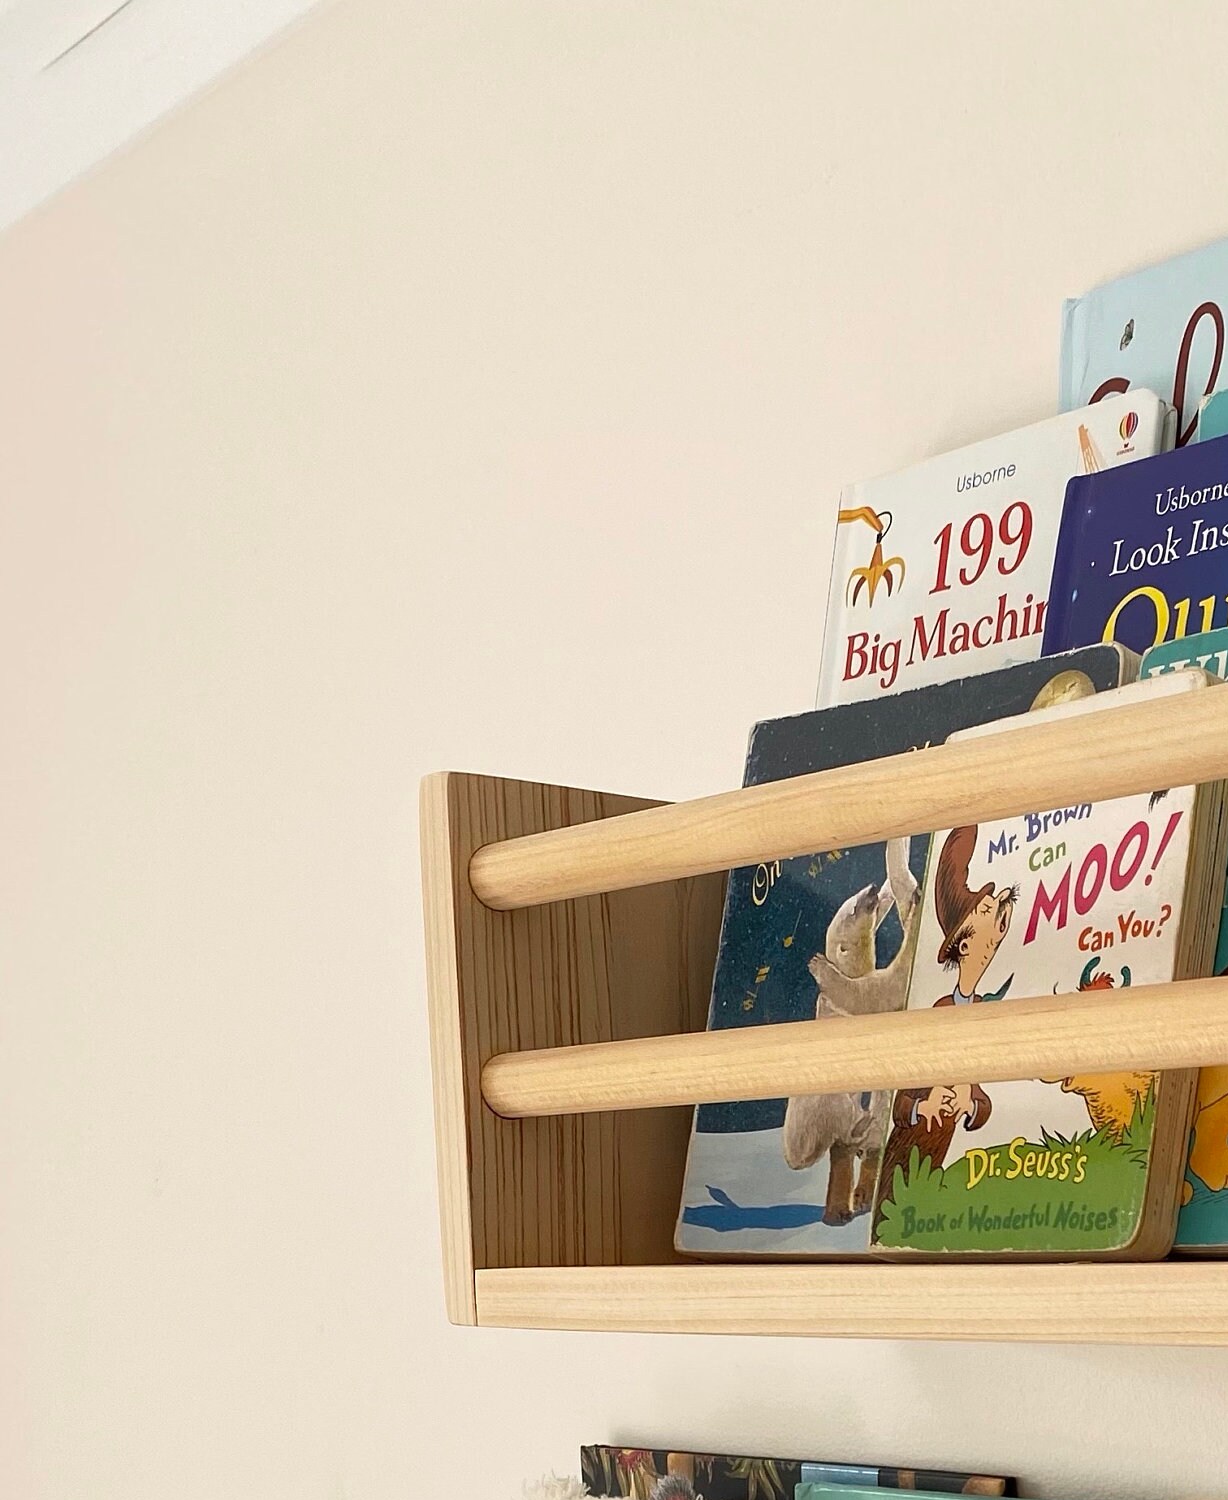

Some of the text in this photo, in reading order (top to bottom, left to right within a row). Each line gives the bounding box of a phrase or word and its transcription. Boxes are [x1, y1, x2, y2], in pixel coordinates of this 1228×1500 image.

[957, 463, 1016, 493] Usborne
[929, 501, 1033, 595] 199
[1109, 526, 1182, 576] Look
[842, 632, 902, 689] Big
[988, 803, 1092, 864] Mr. Brown
[1028, 841, 1067, 872] Can
[1023, 811, 1184, 946] MOO!
[1078, 904, 1172, 952] Can You?
[965, 1137, 1088, 1191] Dr. Seuss's
[901, 1200, 1119, 1239] Book of Wonderful Noises
